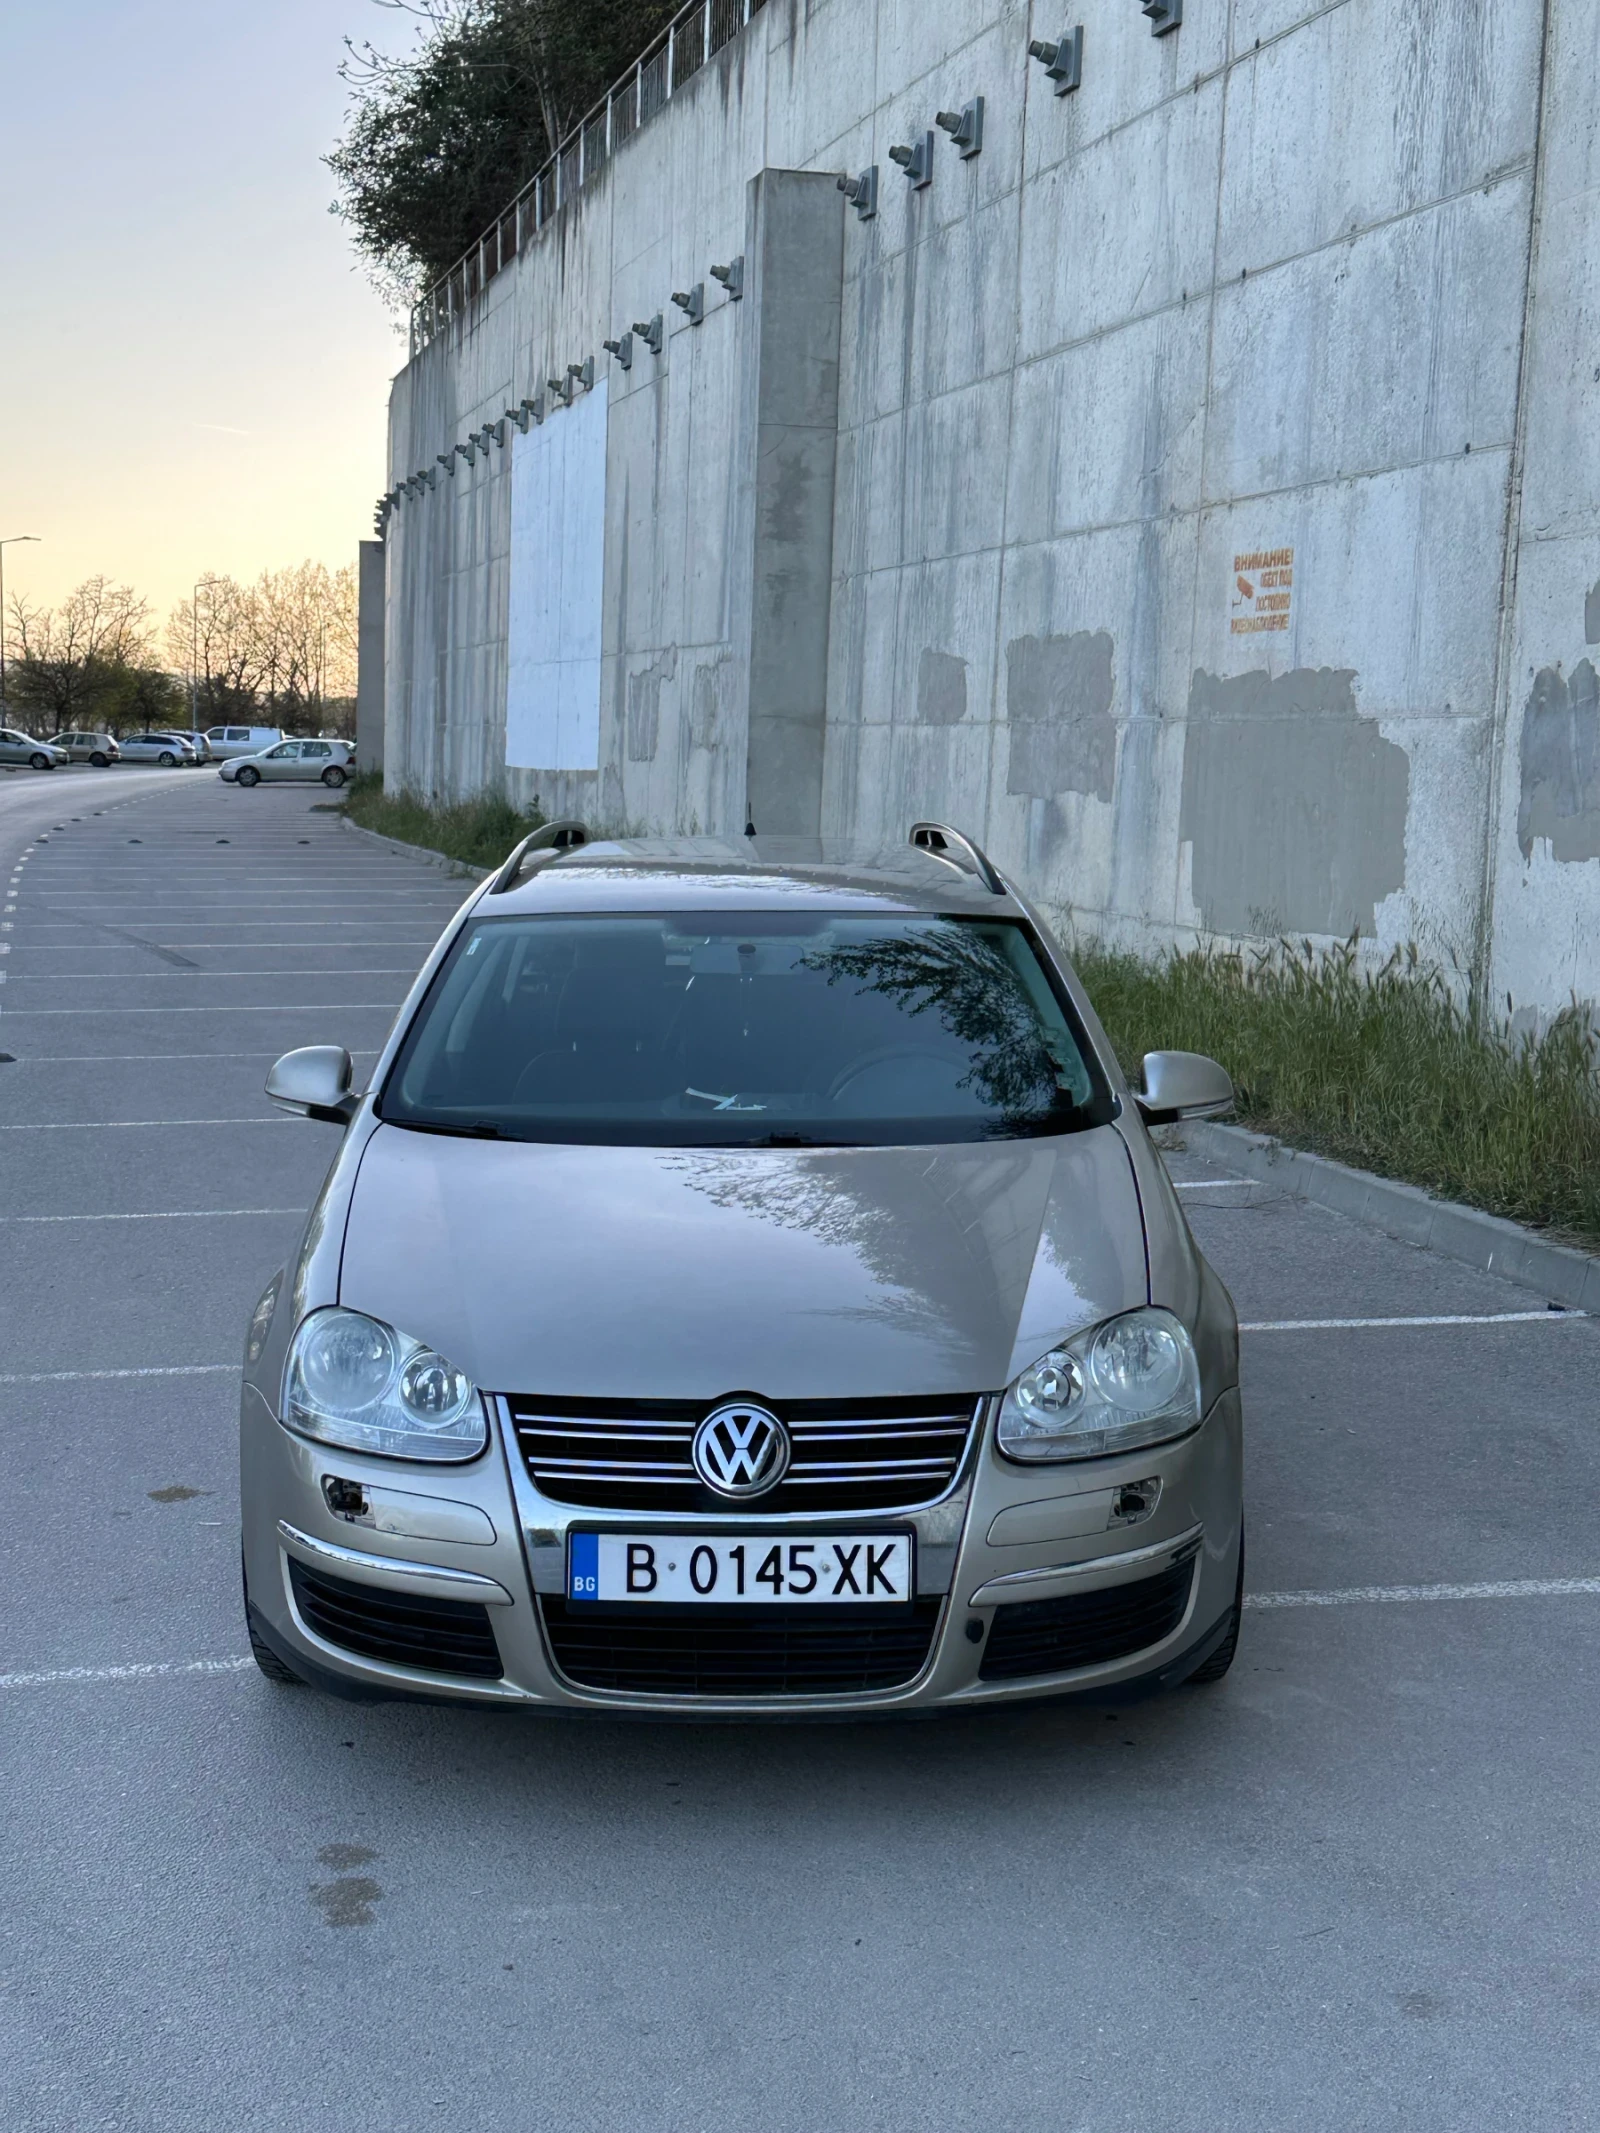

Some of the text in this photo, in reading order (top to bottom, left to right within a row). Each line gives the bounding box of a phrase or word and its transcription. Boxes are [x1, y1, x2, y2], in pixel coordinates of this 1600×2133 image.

[702, 1411, 780, 1489] VW
[574, 1577, 596, 1591] BG
[626, 1543, 897, 1595] B 0145 XK
